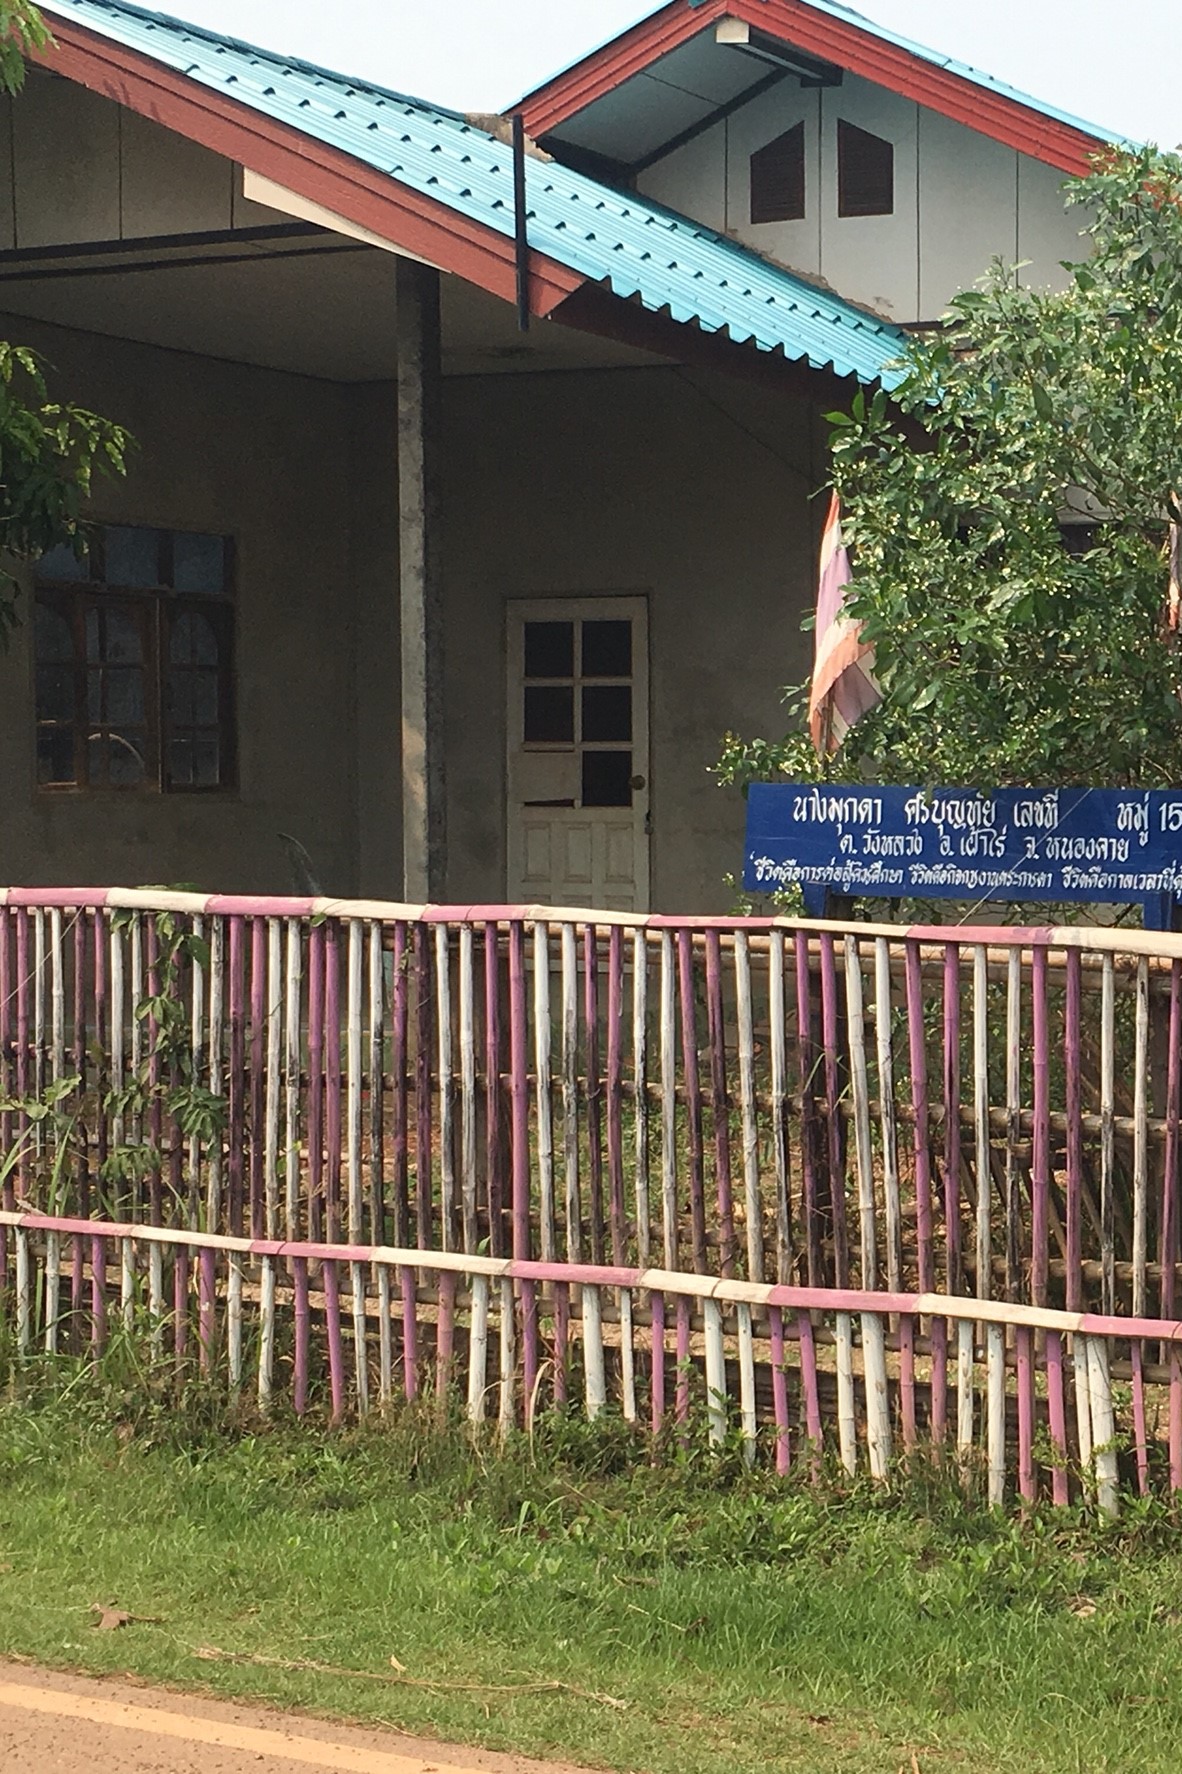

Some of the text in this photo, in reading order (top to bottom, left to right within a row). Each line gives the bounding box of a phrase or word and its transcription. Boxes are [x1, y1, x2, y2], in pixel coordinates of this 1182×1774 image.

[1013, 788, 1059, 829] เลขที่
[1116, 791, 1150, 846] หมู่
